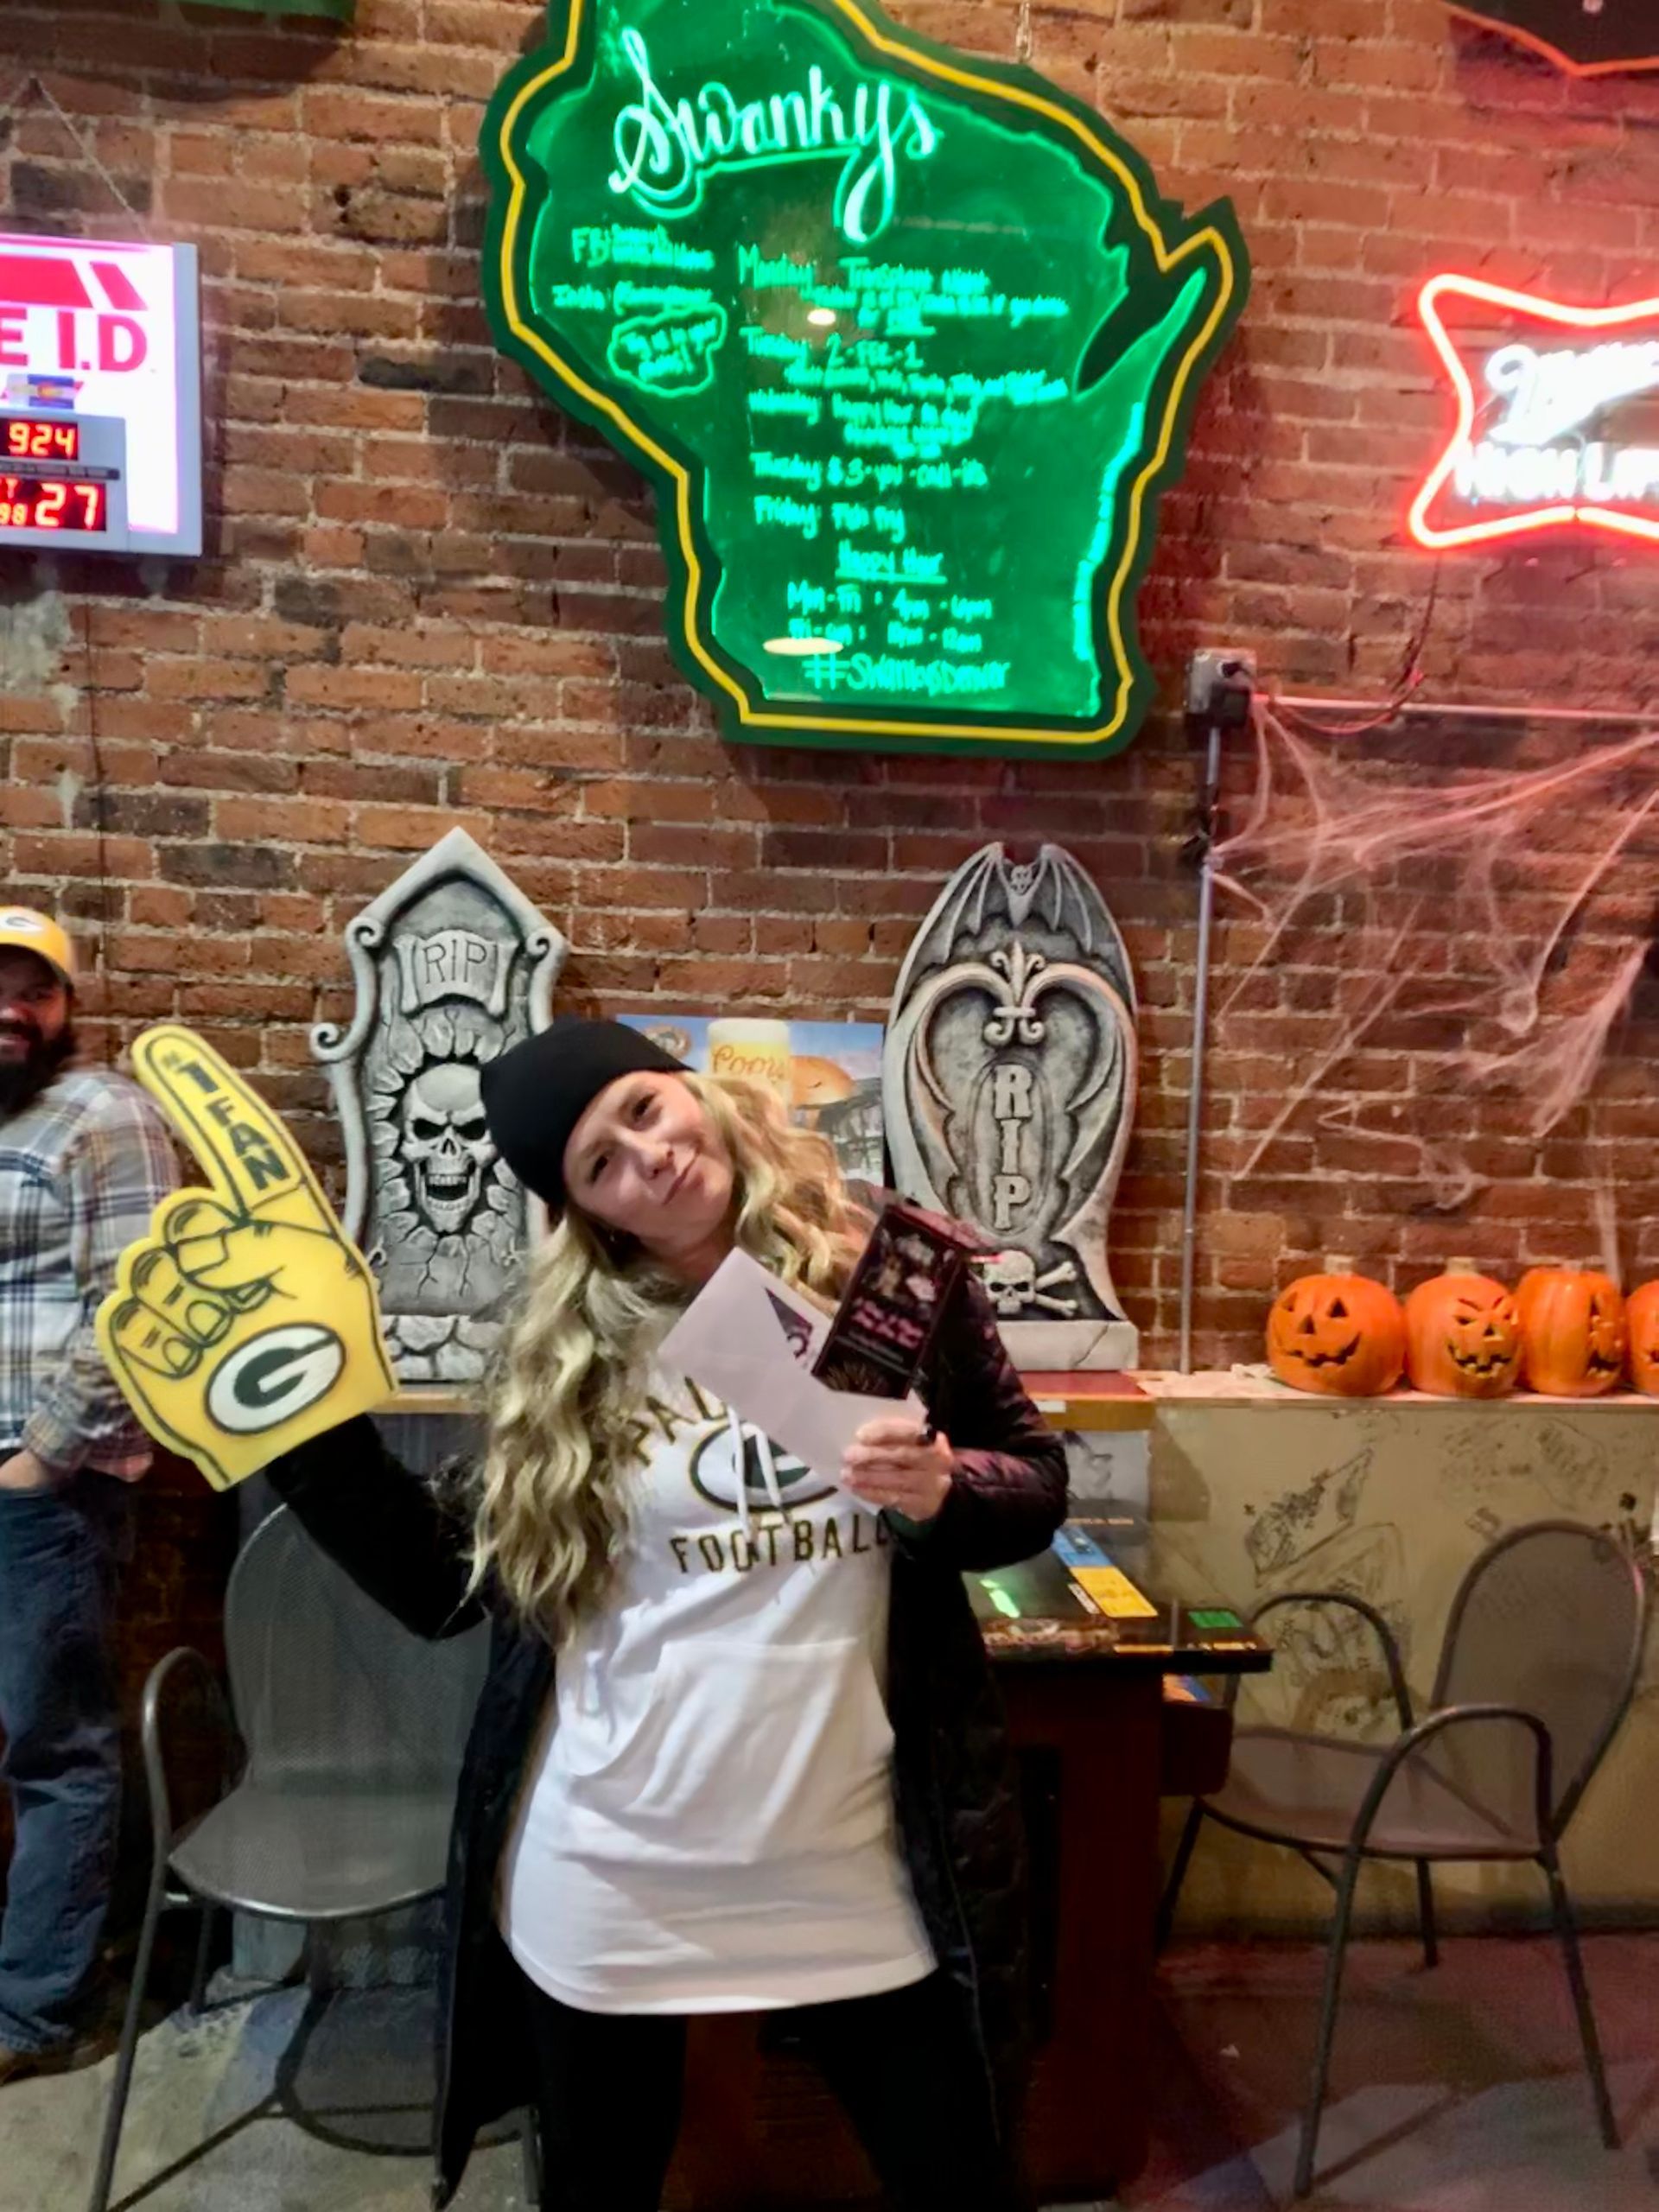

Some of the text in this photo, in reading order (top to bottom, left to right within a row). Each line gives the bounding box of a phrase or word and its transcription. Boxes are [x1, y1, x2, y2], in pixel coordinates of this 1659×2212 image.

[422, 938, 487, 984] RIP
[205, 1095, 290, 1192] FAN
[995, 1064, 1034, 1230] RIP
